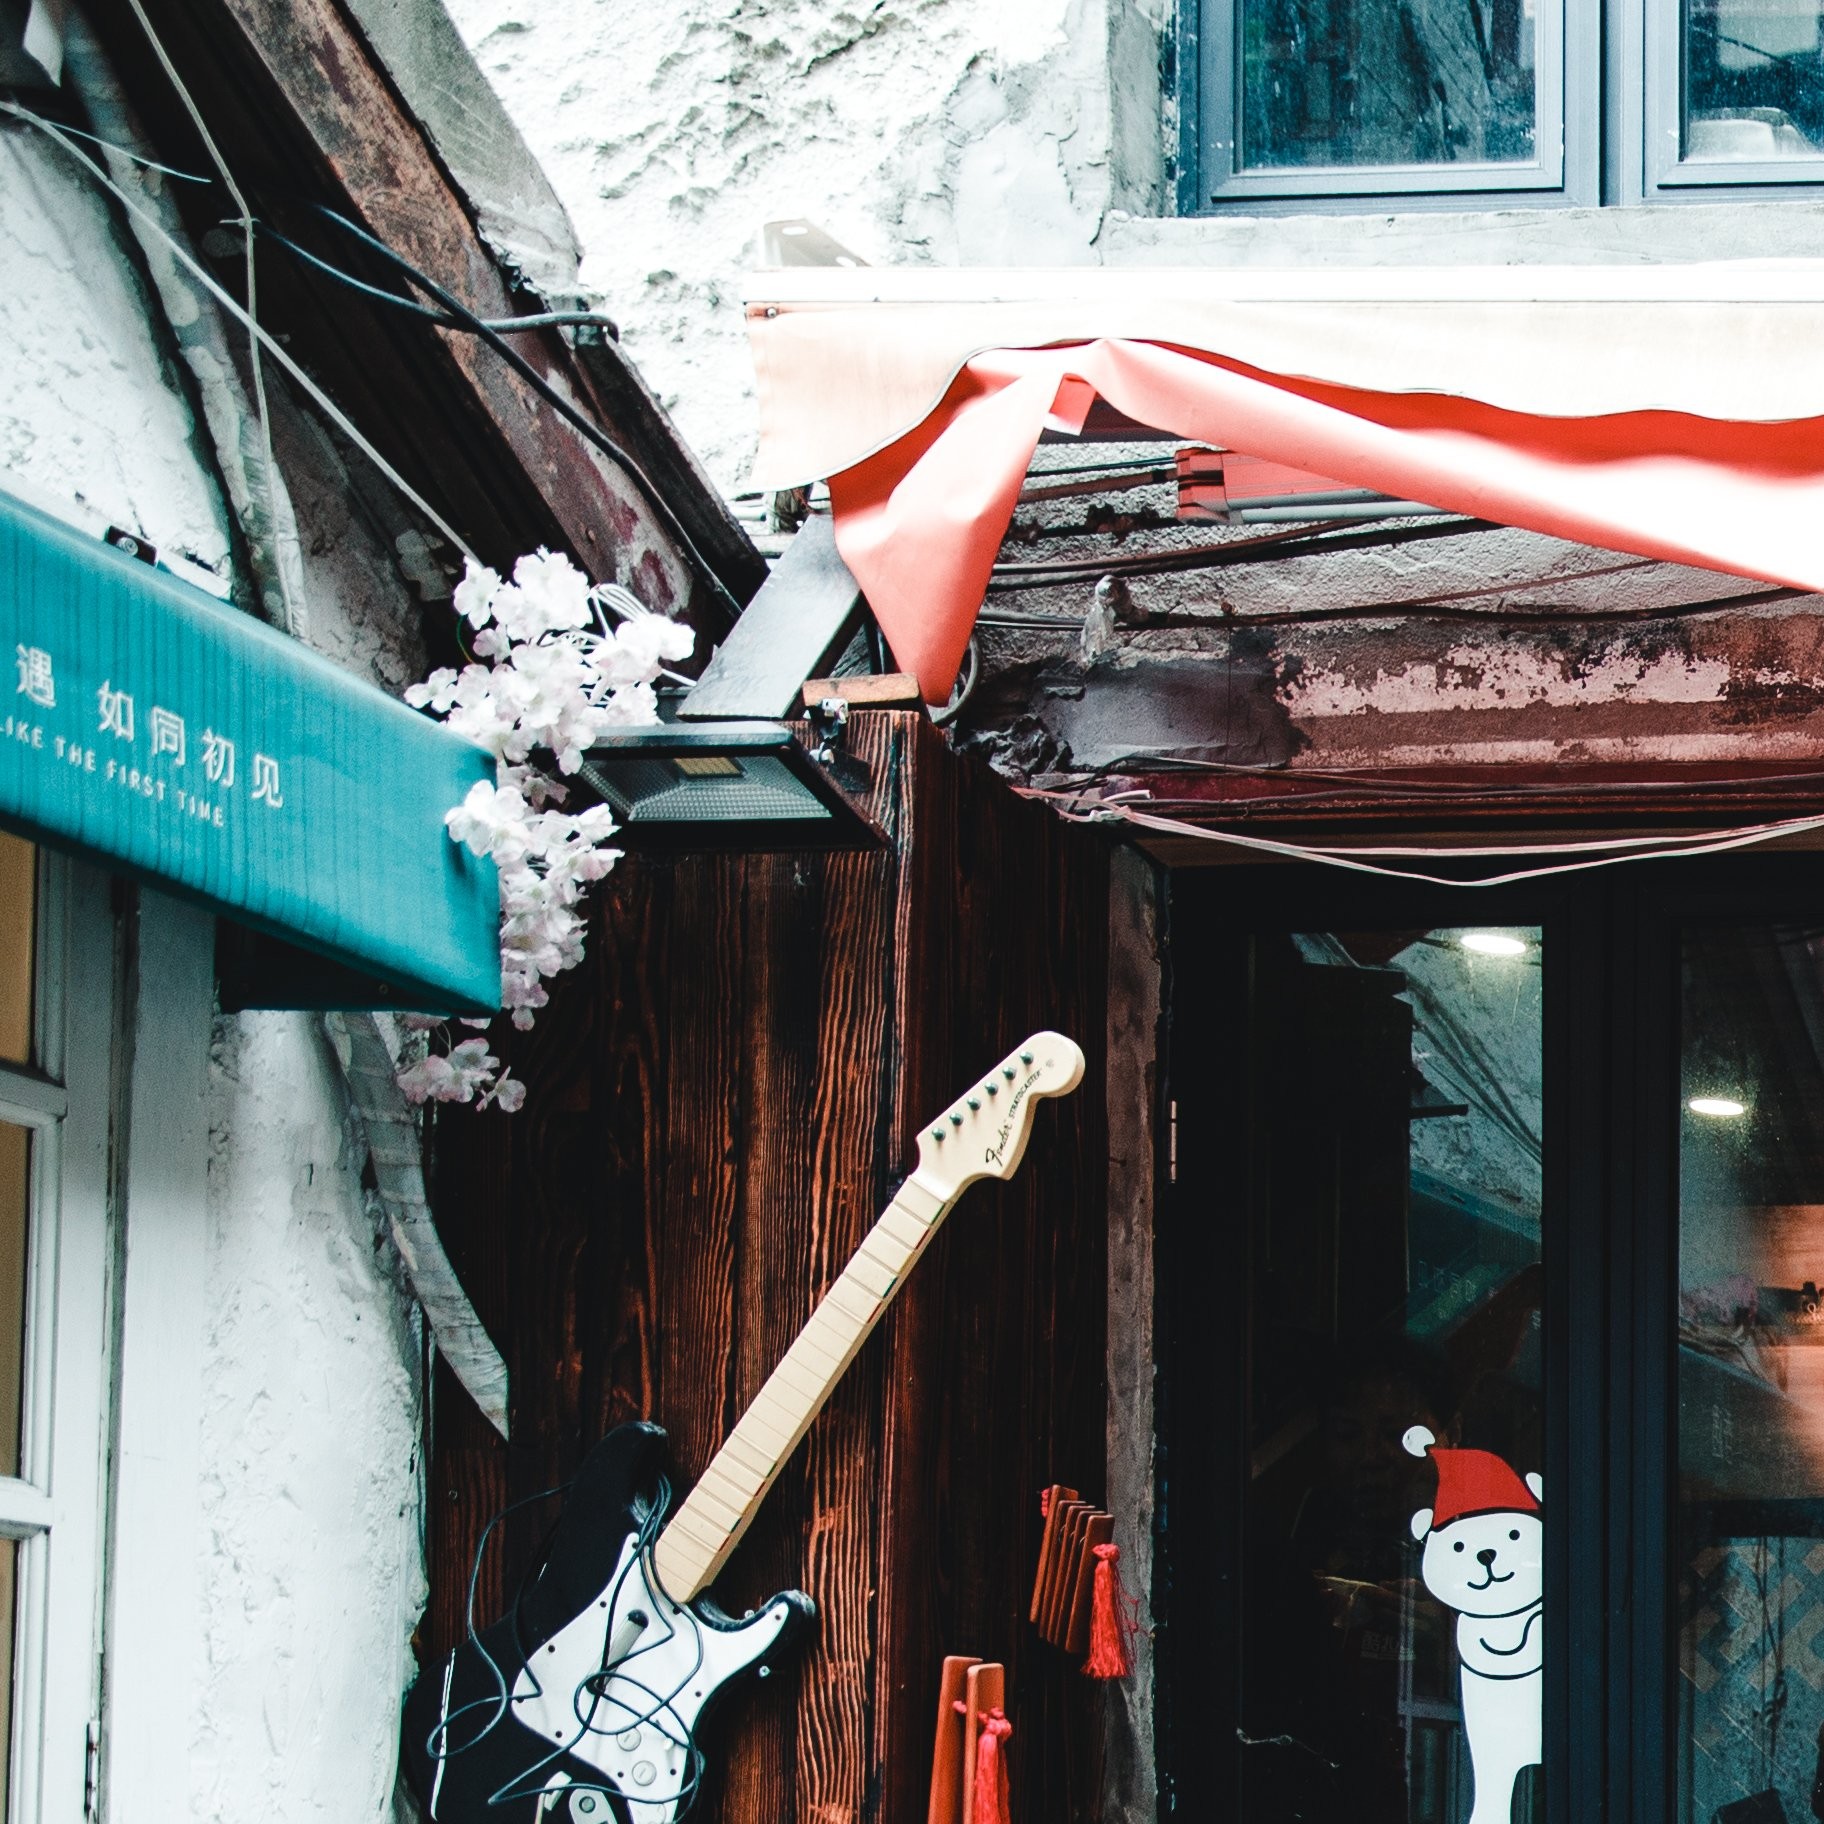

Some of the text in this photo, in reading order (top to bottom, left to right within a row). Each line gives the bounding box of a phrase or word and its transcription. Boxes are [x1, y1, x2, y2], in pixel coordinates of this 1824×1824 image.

[15, 643, 284, 809] 遇 如同初见
[54, 735, 97, 772] THE
[106, 759, 166, 801] FIRST
[177, 790, 224, 828] TIME
